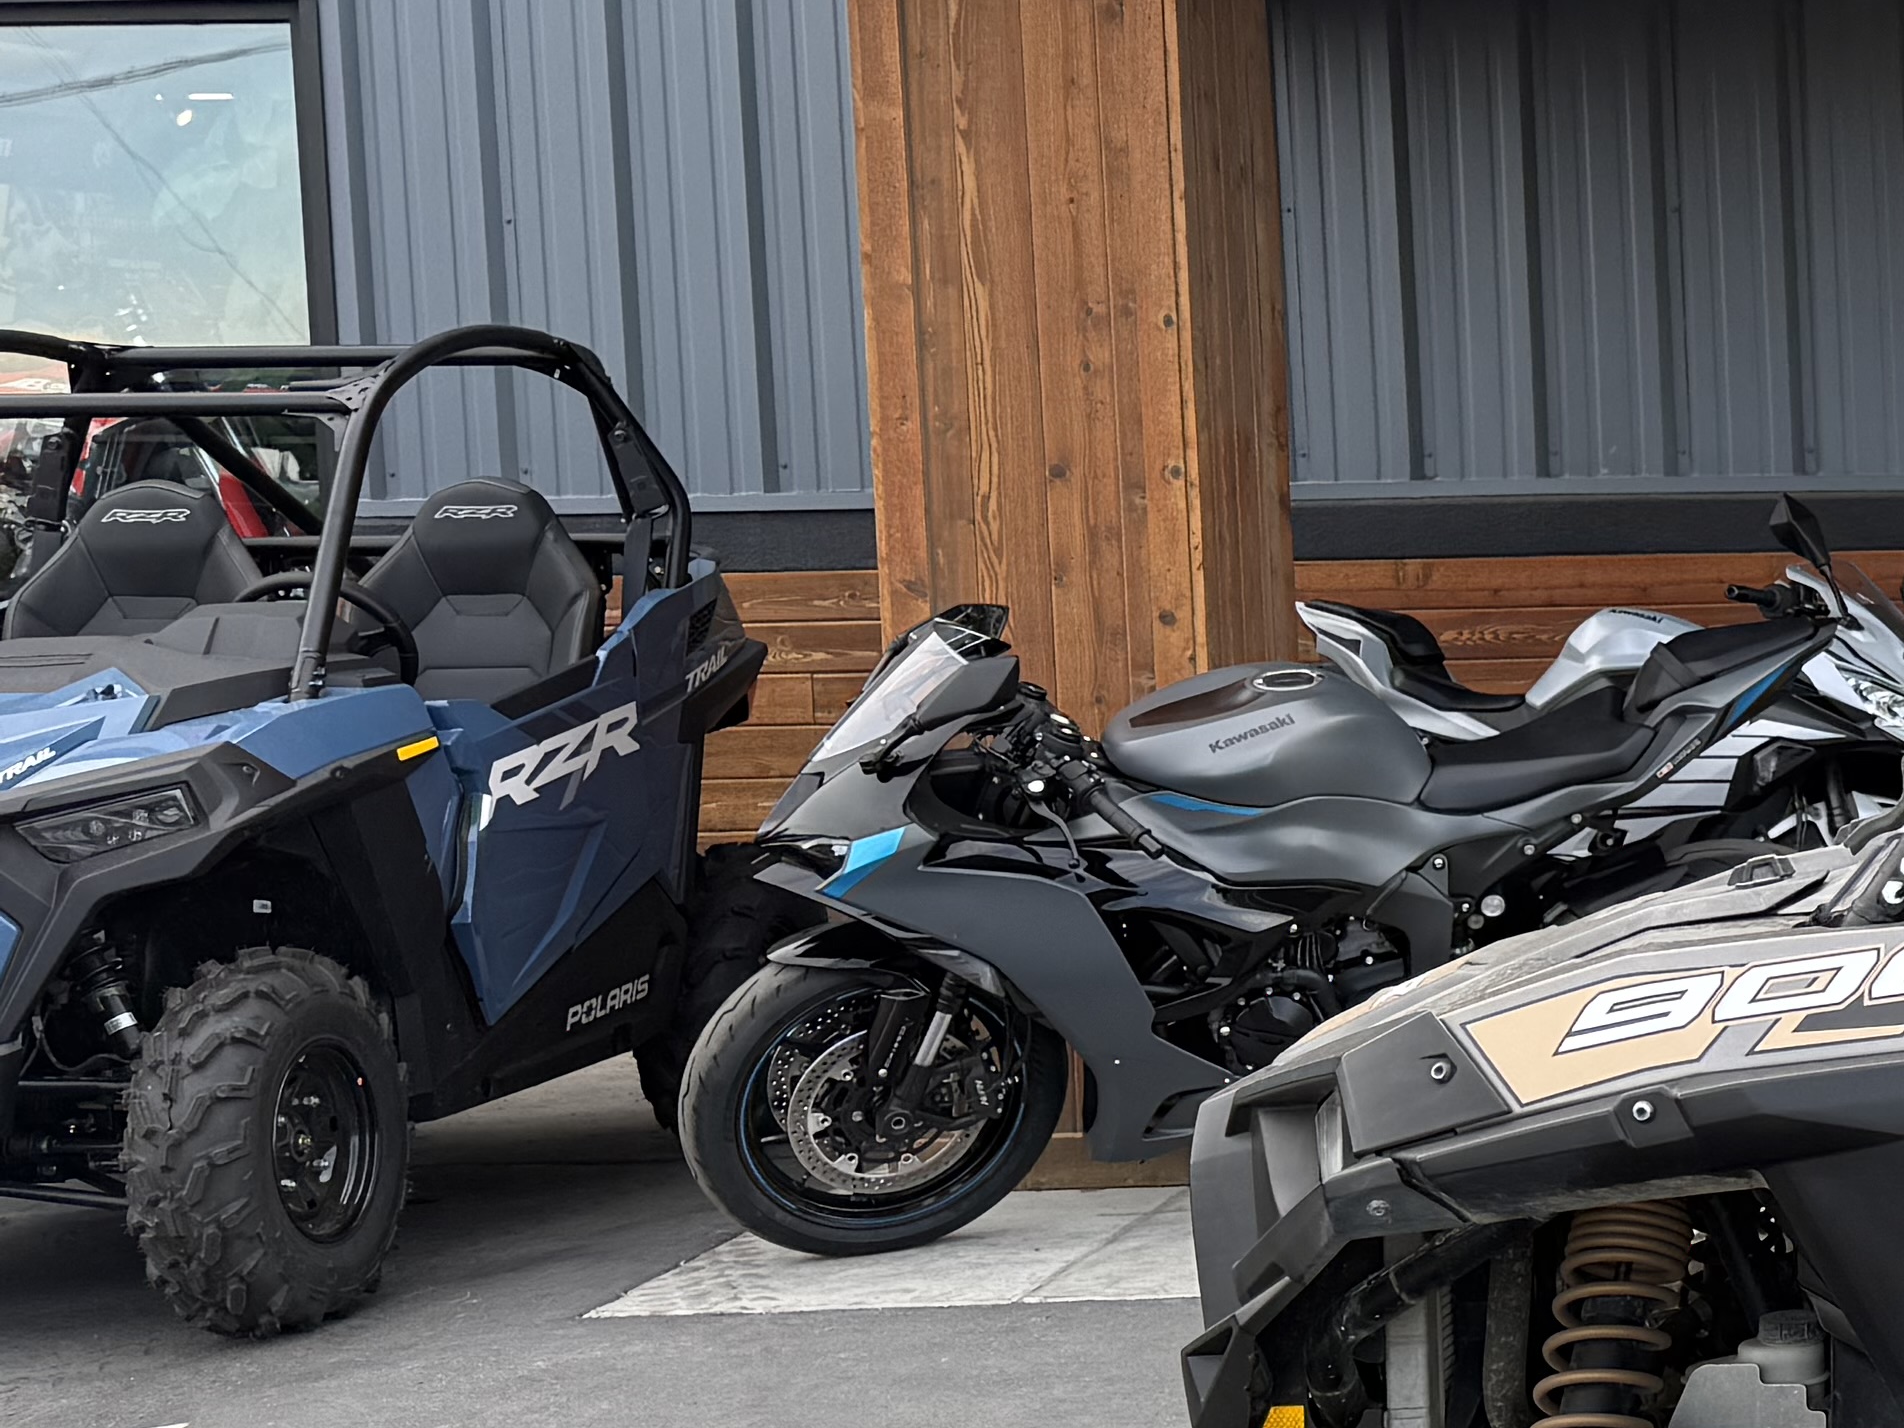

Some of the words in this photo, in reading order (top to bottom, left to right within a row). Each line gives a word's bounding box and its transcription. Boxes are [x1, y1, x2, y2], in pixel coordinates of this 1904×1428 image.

[685, 645, 729, 693] TRAIL
[1208, 713, 1296, 754] Kawasaki
[480, 701, 640, 831] RZR
[566, 974, 650, 1032] POLARIS
